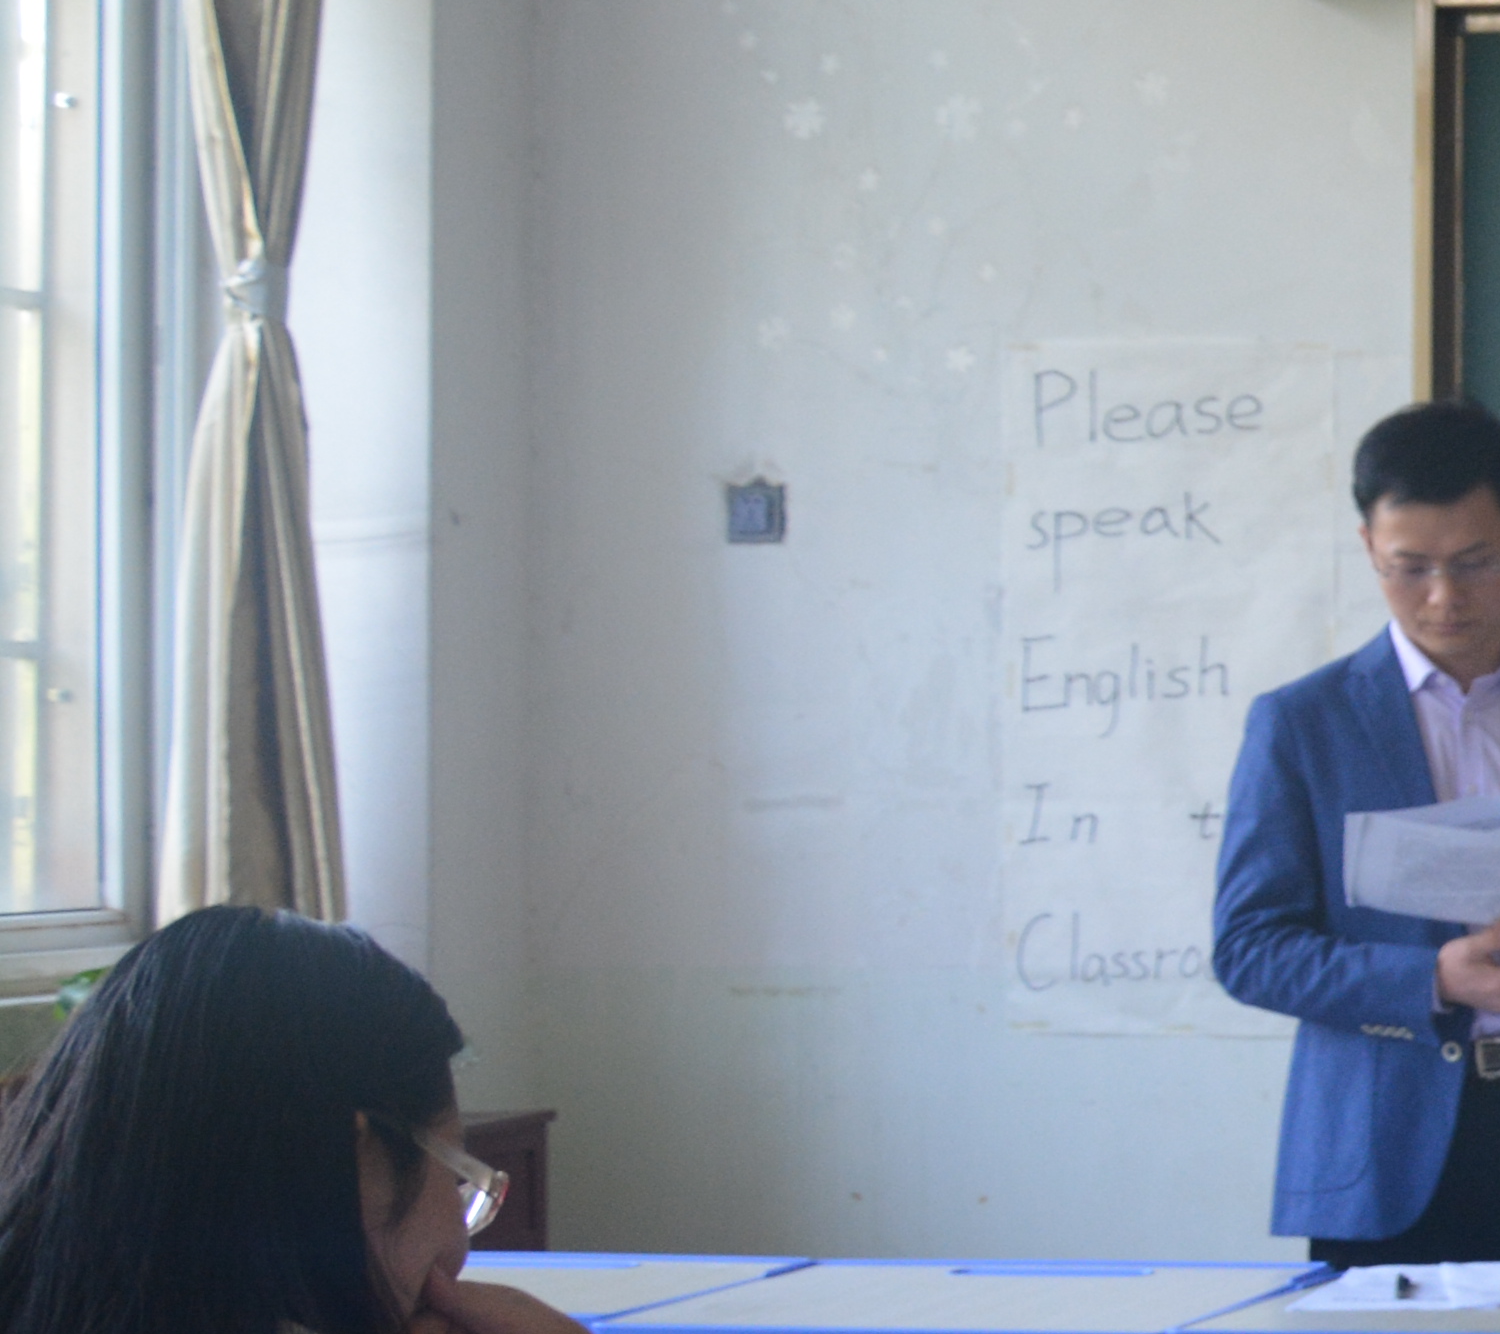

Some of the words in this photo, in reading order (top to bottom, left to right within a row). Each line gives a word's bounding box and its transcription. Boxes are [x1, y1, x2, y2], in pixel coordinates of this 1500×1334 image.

[1033, 368, 1264, 447] Please
[1026, 491, 1221, 594] speak
[1020, 634, 1229, 739] English
[1019, 782, 1097, 846] In
[1016, 911, 1216, 992] Classro
